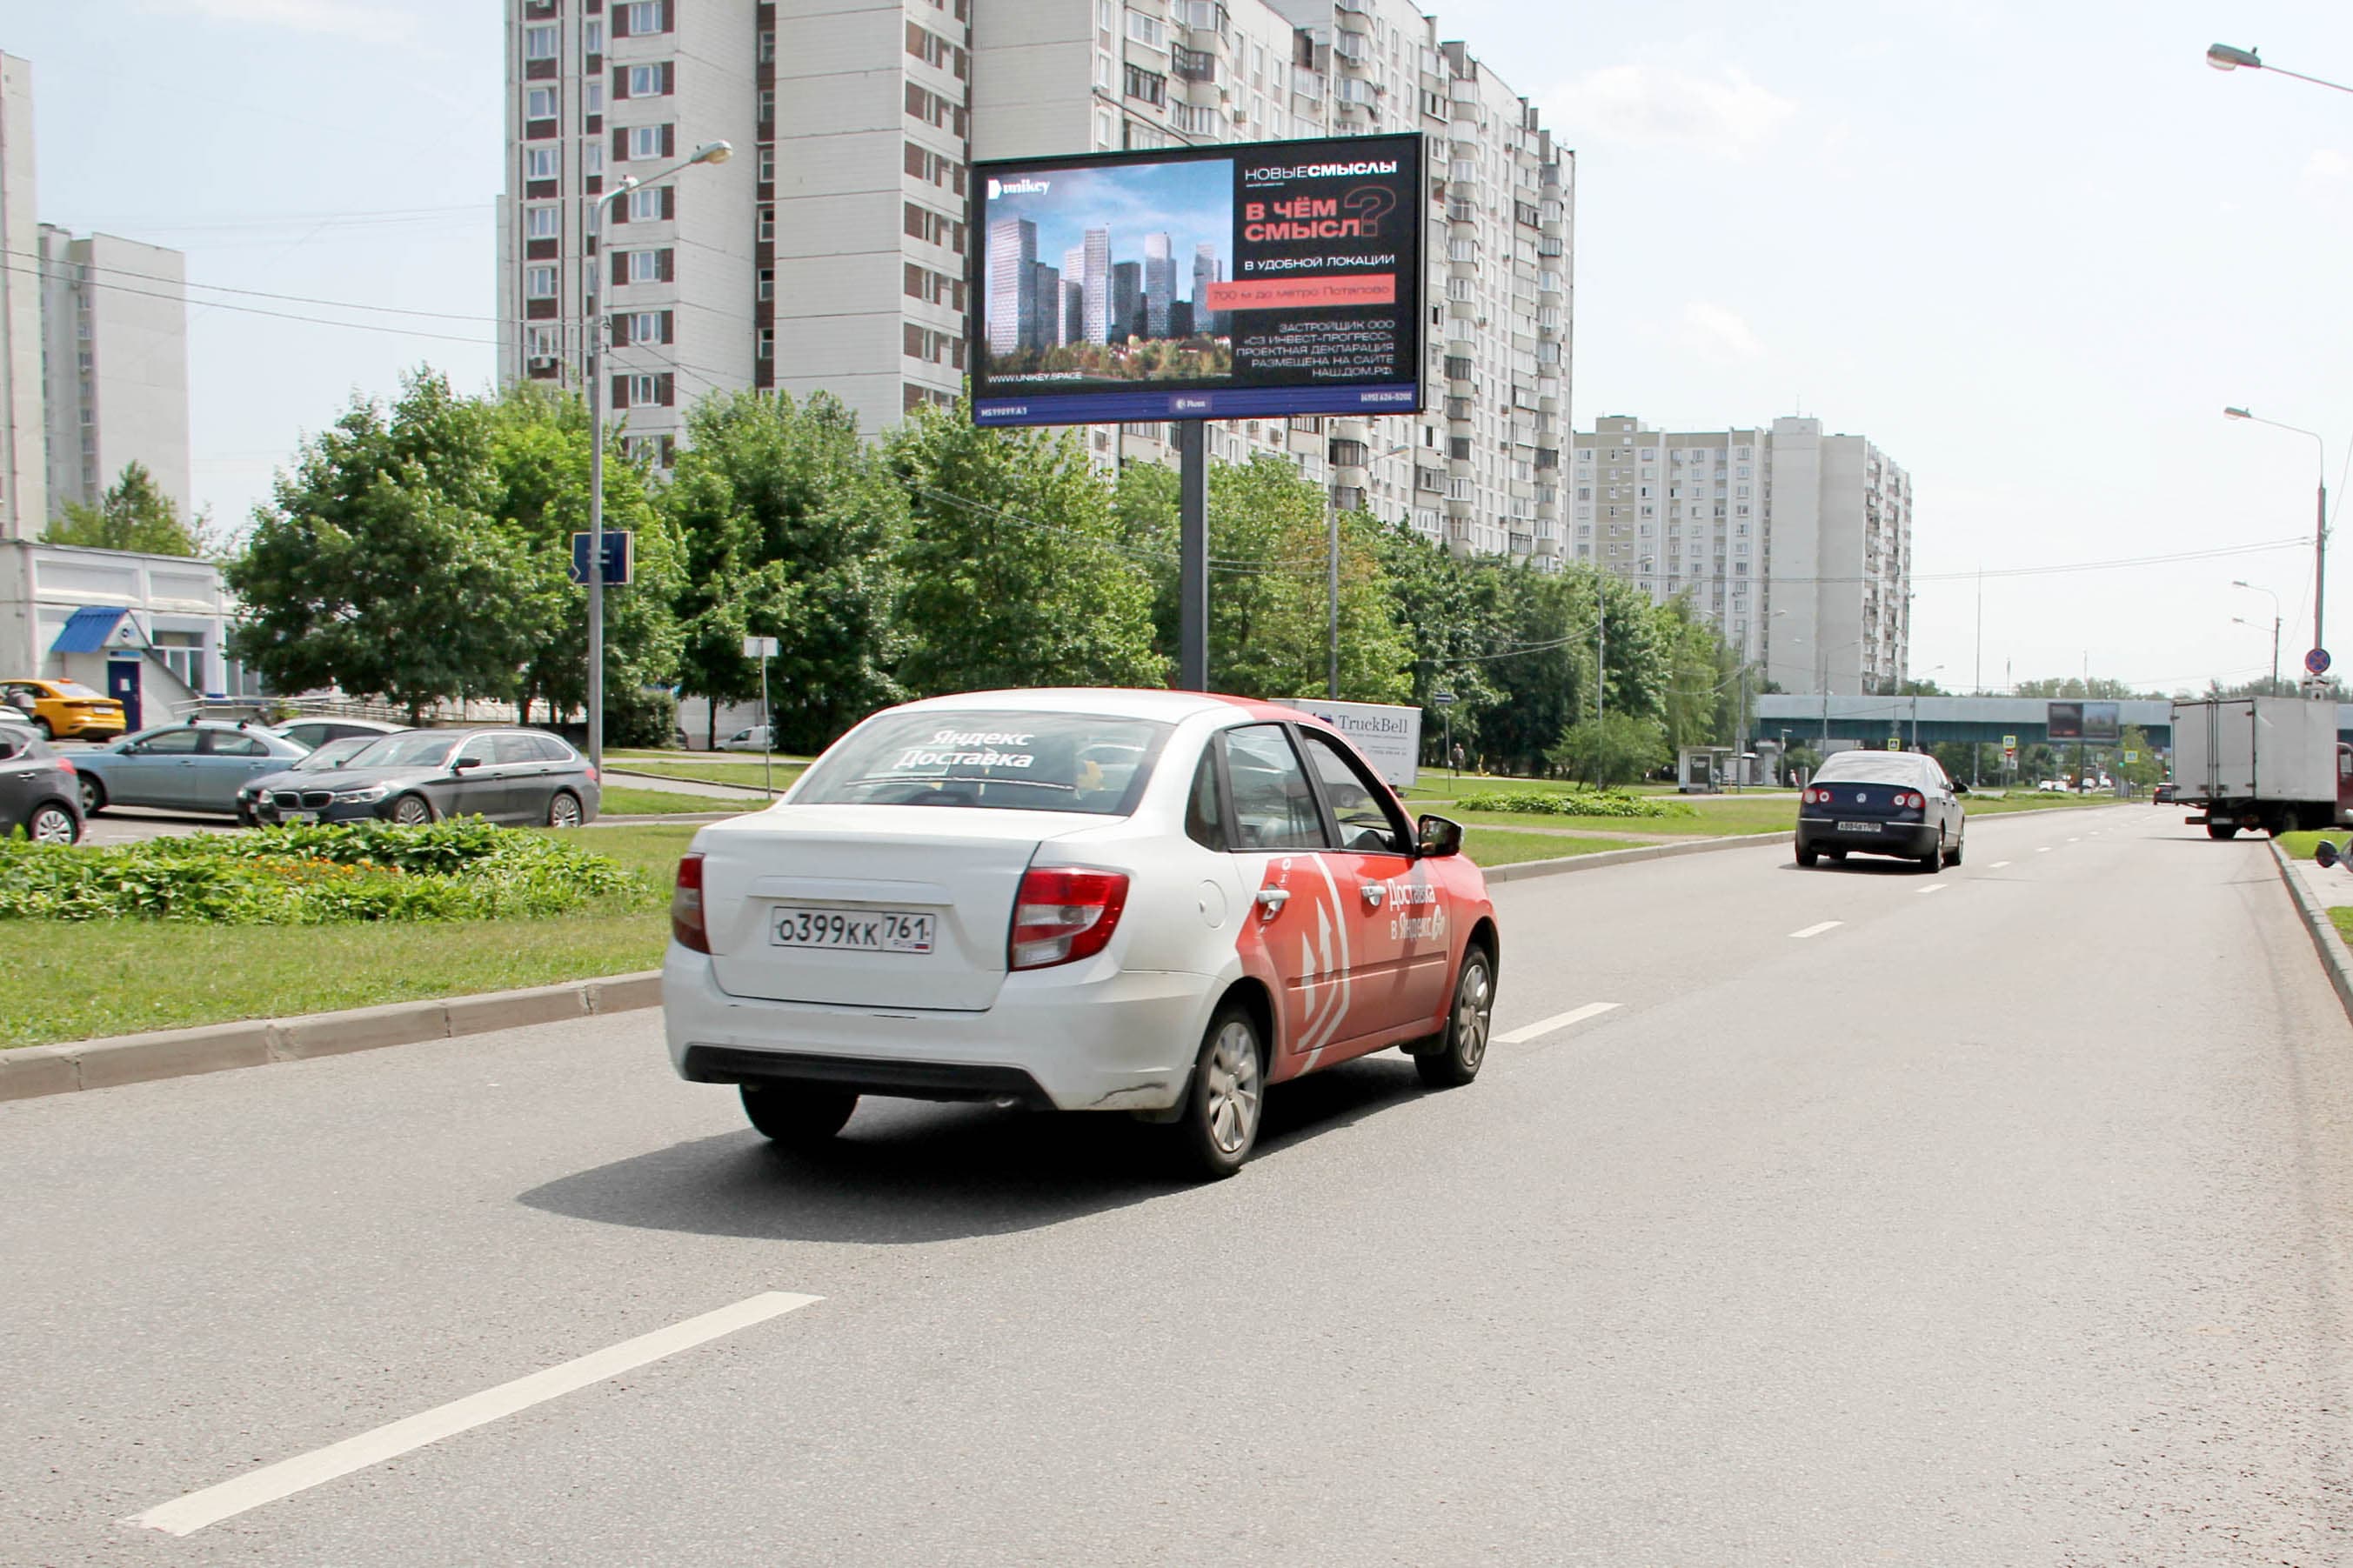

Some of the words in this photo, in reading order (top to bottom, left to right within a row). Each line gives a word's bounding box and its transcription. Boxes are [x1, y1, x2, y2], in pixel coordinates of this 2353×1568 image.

[1003, 178, 1050, 195] unikey
[1246, 202, 1265, 221] В
[1273, 196, 1337, 219] ЧЁМ
[1245, 260, 1254, 270] В
[1258, 257, 1323, 270] УДОБНОЙ
[1326, 253, 1395, 267] ЛОКАЦИИ
[1213, 290, 1237, 301] 700
[1255, 290, 1273, 301] до
[1277, 288, 1319, 298] метро
[1323, 284, 1390, 297] Потапово
[1279, 321, 1365, 333] ЗАСТРОЙЩИК
[1367, 319, 1395, 330] ООО
[1236, 345, 1308, 357] ПРОЕКТНАЯ
[1311, 343, 1394, 355] ДЕКЛАРАЦИЯ
[1252, 356, 1330, 368] РАЗМЕЩЕНА
[1333, 355, 1350, 365] НА
[1353, 353, 1394, 364] САЙТЕ
[987, 371, 1082, 383] WWW.UNIKEY.SPACE
[1339, 714, 1408, 733] TruckBell
[927, 730, 1035, 746] Яндекс
[892, 750, 1035, 770] Доставка
[1387, 877, 1436, 911] Доставка
[885, 916, 926, 940] 761
[1391, 919, 1397, 940] в
[1399, 911, 1432, 940] Яндекс
